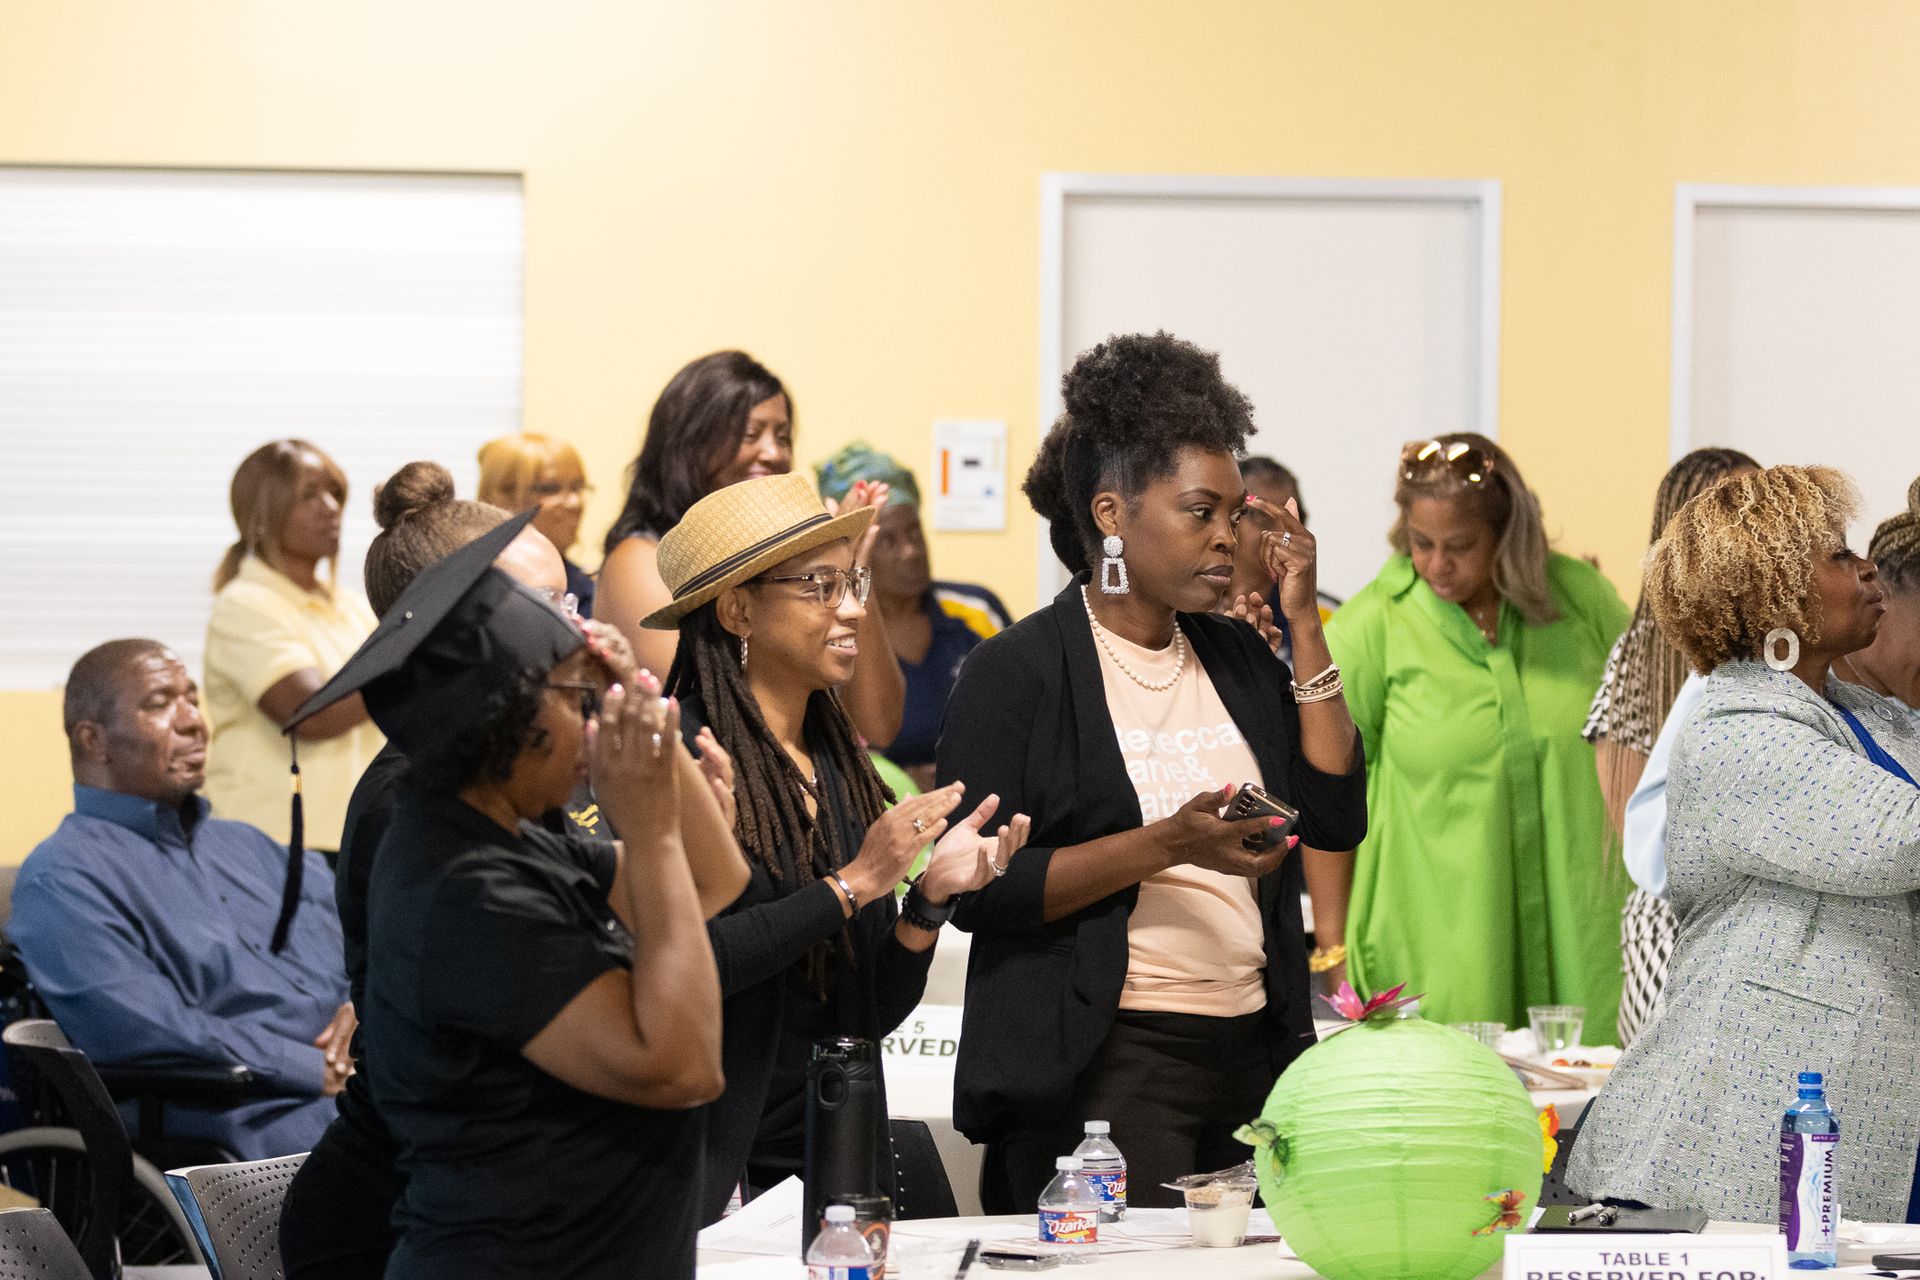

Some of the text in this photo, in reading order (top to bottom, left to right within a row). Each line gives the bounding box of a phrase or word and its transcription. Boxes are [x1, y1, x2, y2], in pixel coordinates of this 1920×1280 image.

[1114, 722, 1243, 755] eecca
[914, 1021, 925, 1034] 5
[1598, 1252, 1689, 1266] TABLE 1
